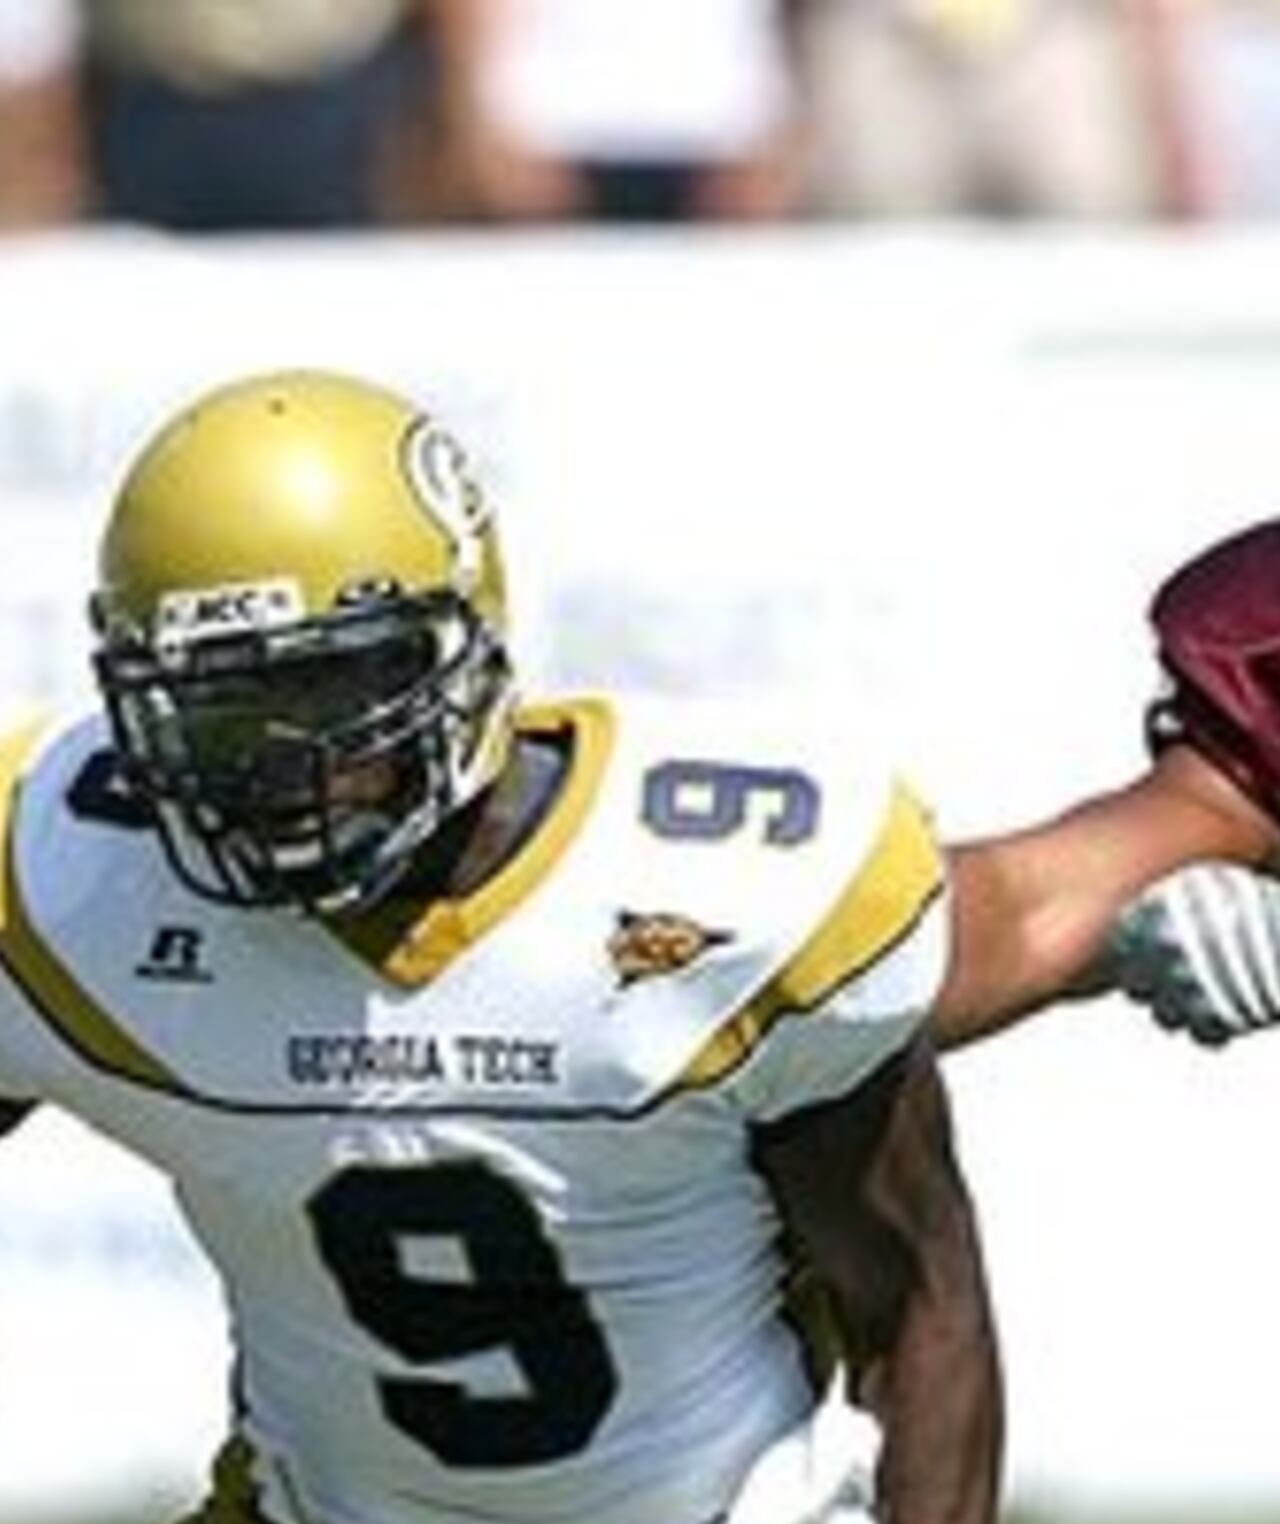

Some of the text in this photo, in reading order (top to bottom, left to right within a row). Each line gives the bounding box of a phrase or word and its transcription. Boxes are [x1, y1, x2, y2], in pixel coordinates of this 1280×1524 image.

[641, 758, 821, 846] 9
[288, 1034, 559, 1085] GEORGIA TECH
[305, 1156, 620, 1469] 9
